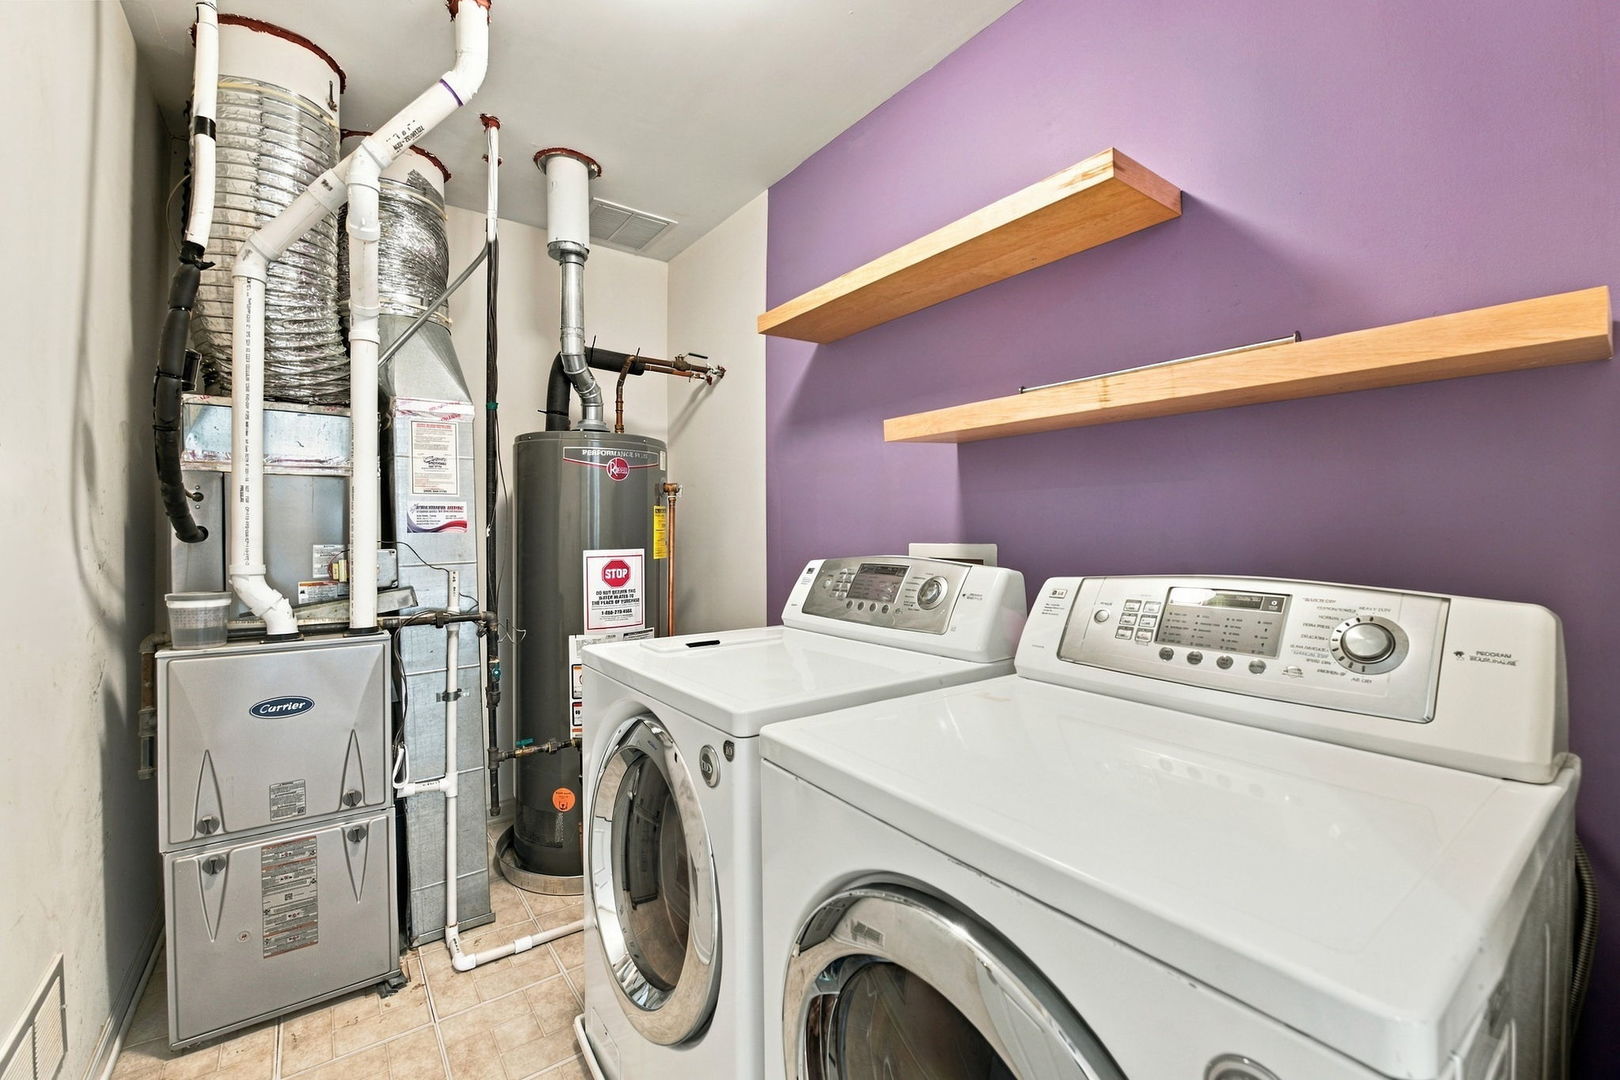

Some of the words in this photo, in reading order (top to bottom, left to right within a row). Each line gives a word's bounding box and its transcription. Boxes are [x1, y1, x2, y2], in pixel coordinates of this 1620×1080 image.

[582, 450, 633, 458] PERFORMANCE
[605, 568, 628, 579] STOP
[260, 702, 306, 714] Carrier
